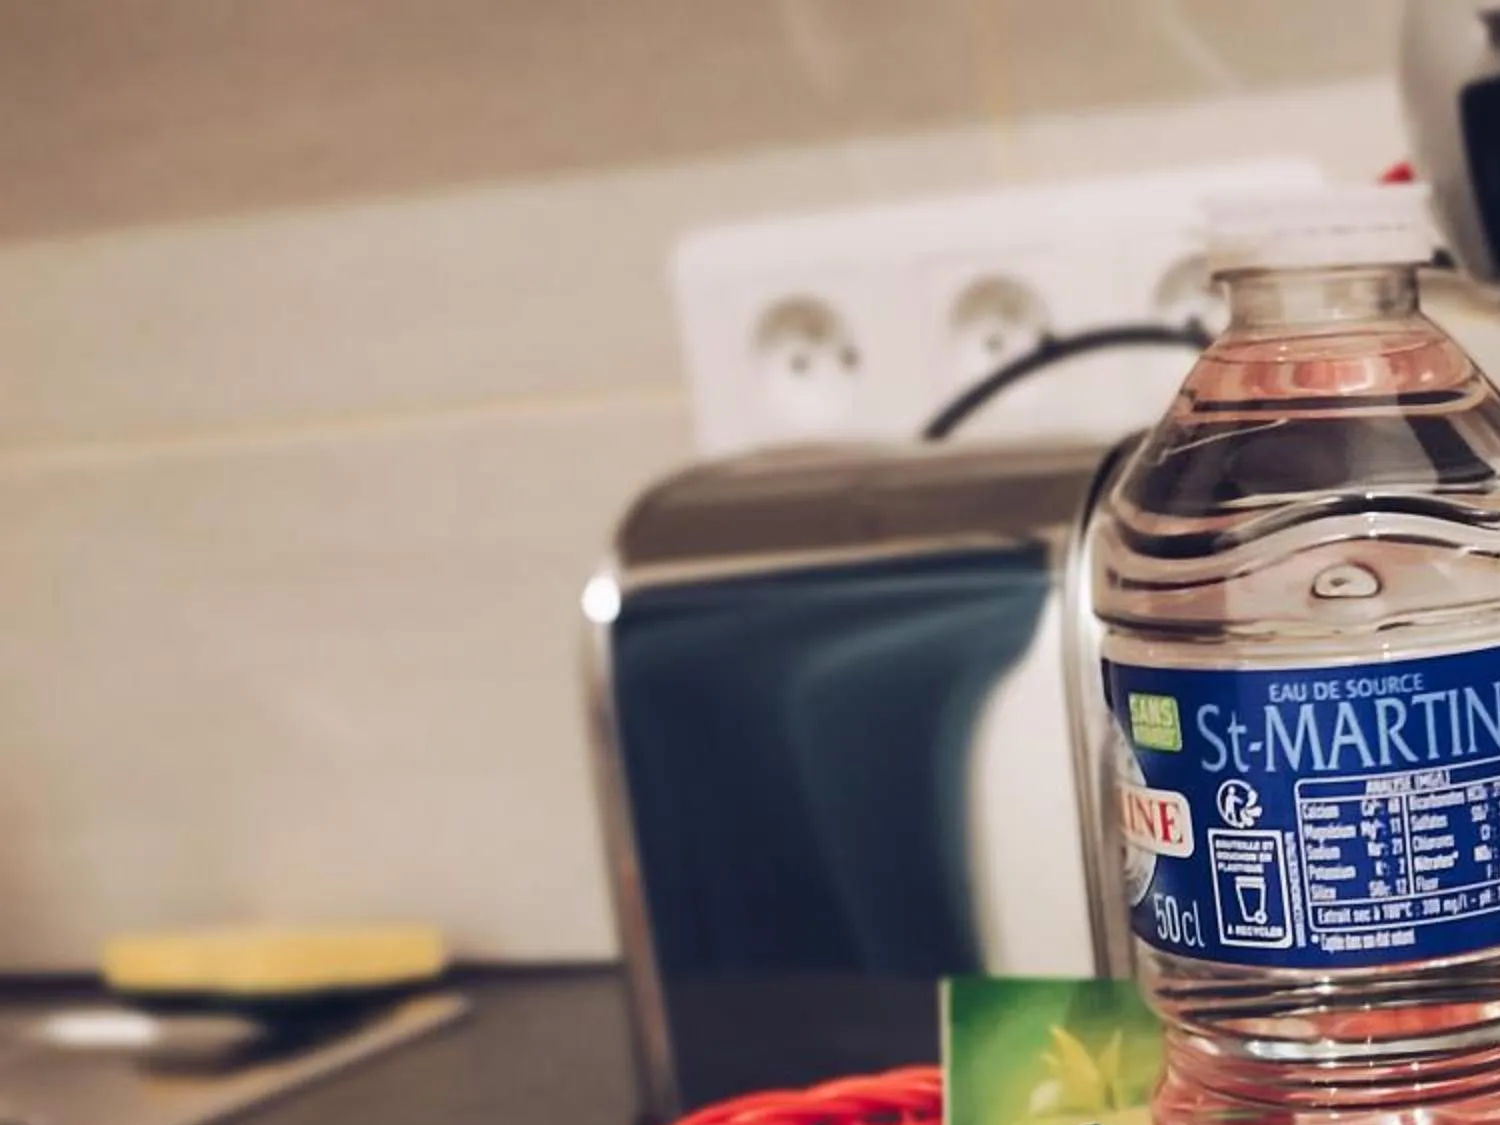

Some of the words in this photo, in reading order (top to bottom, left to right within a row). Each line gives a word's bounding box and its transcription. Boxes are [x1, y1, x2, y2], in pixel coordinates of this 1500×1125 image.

[1268, 683, 1308, 703] EAU
[1312, 681, 1340, 701] DE
[1345, 673, 1425, 700] SOURCE
